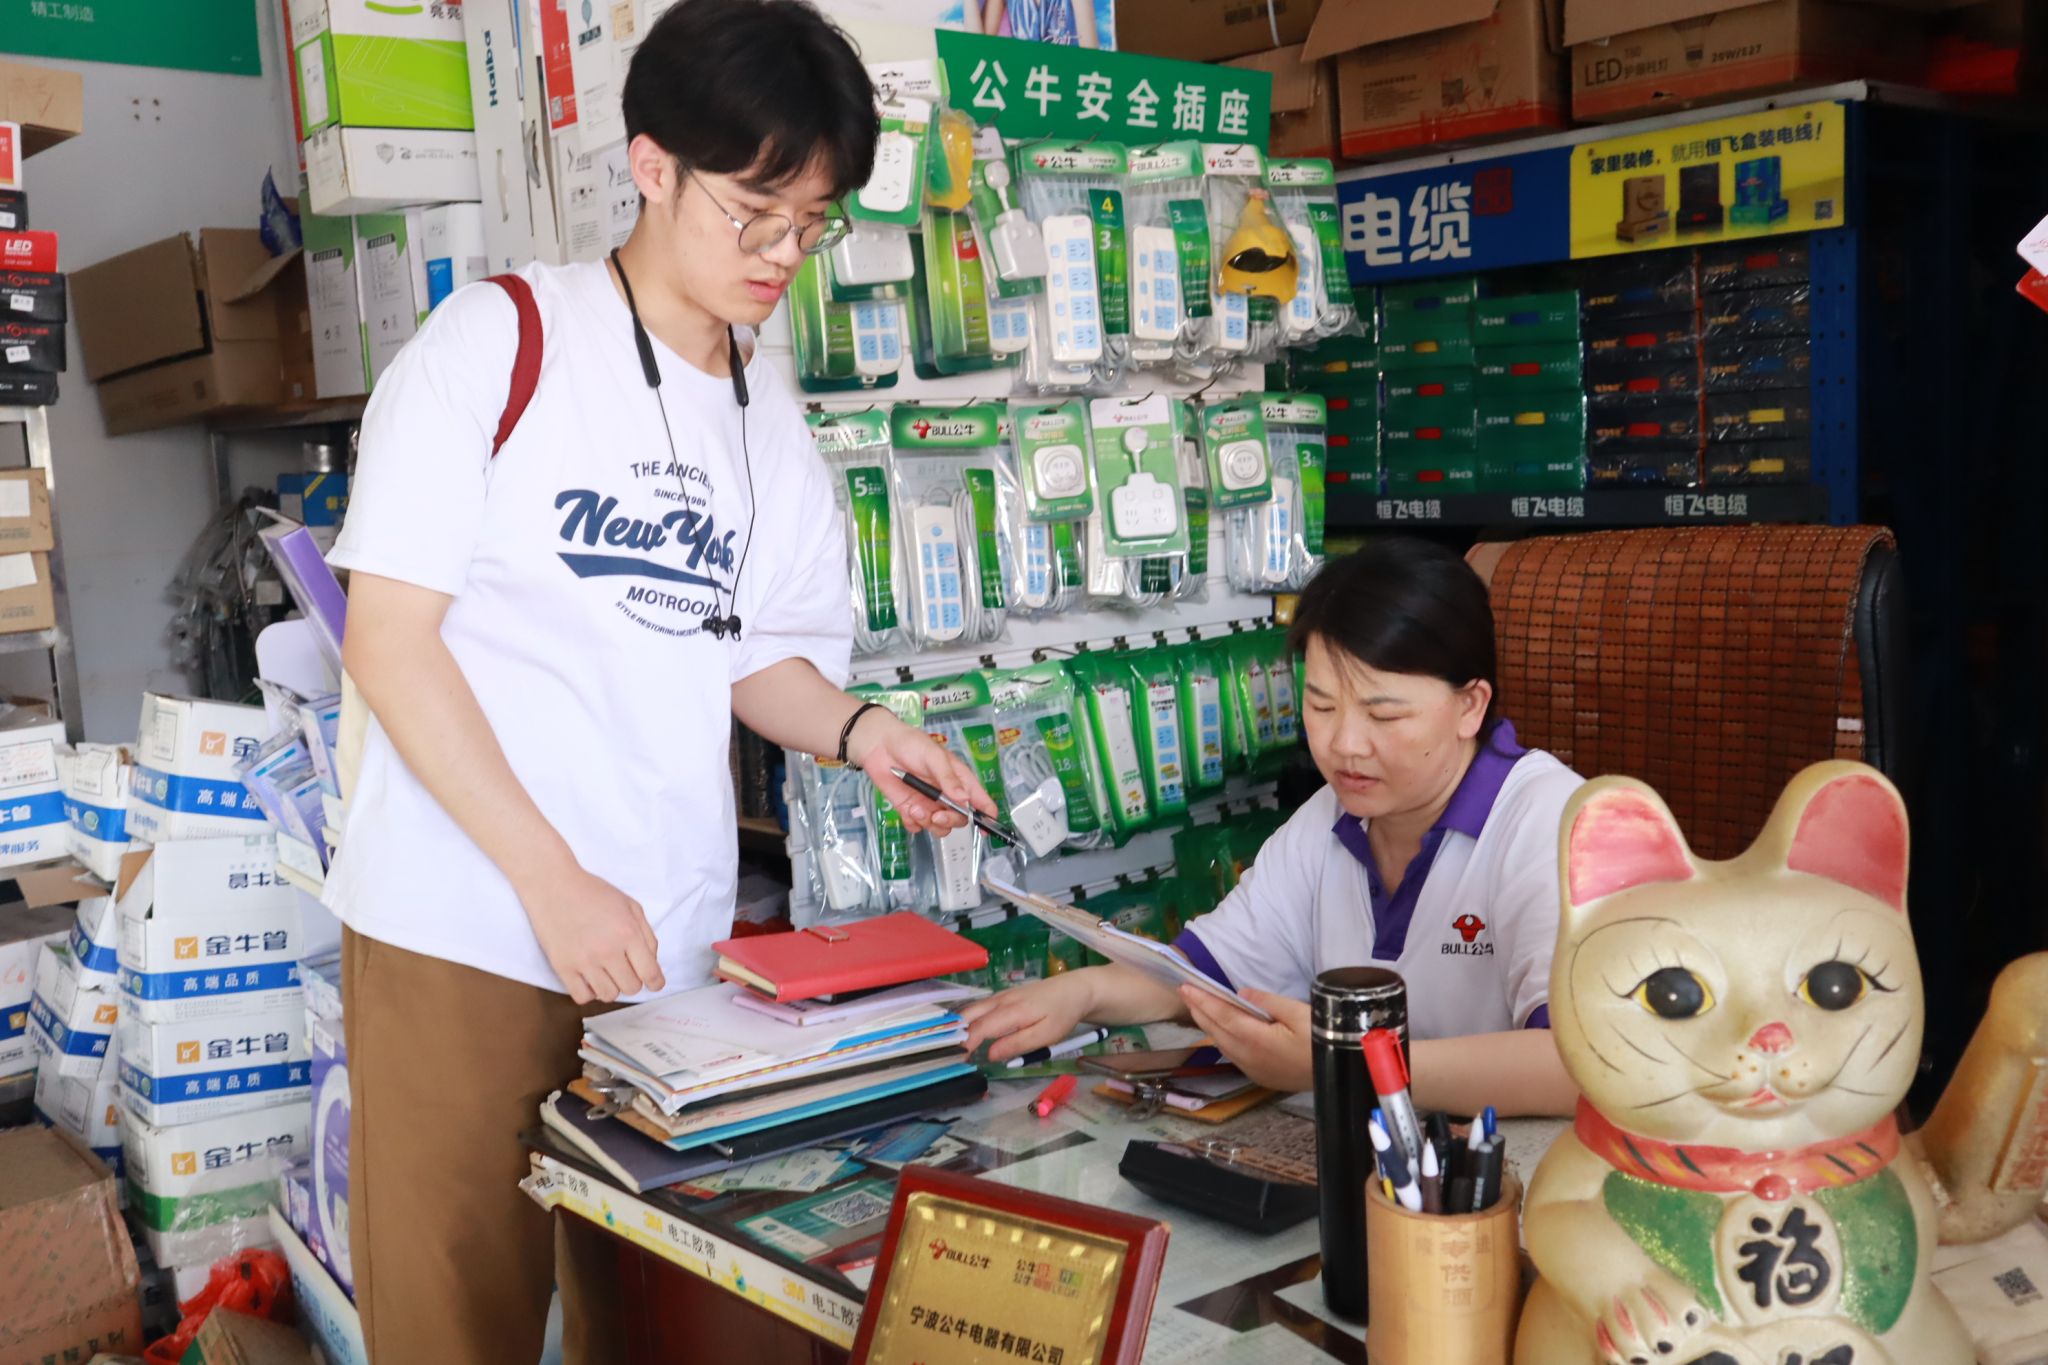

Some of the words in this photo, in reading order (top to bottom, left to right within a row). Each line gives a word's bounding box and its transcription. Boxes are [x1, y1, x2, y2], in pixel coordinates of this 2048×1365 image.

[31, 1, 94, 21] 精工制造
[1585, 58, 1622, 87] LED
[969, 59, 1251, 137] 公牛安全插座
[1101, 196, 1115, 214] 4
[1343, 181, 1472, 267] 电缆
[5, 239, 33, 252] LED
[1099, 229, 1112, 250] 3
[931, 423, 976, 437] BULL公牛
[1301, 449, 1312, 468] 3
[630, 461, 661, 478] THE
[664, 462, 714, 496] ANCIE
[854, 476, 869, 497] 5
[971, 477, 982, 492] 5
[654, 488, 685, 502] SINCE
[1664, 494, 1748, 516] 恒飞电缆
[1376, 499, 1442, 520] 恒飞电缆
[1511, 496, 1585, 518] 恒飞电缆
[554, 489, 667, 552] New
[662, 510, 737, 575] Yok
[1440, 942, 1495, 956] BULL公牛
[183, 969, 260, 992] 高端品质
[185, 1072, 262, 1096] 高端品质
[1737, 1206, 1832, 1309] 福
[910, 1304, 1065, 1365] 宁波公牛电器有限公司
